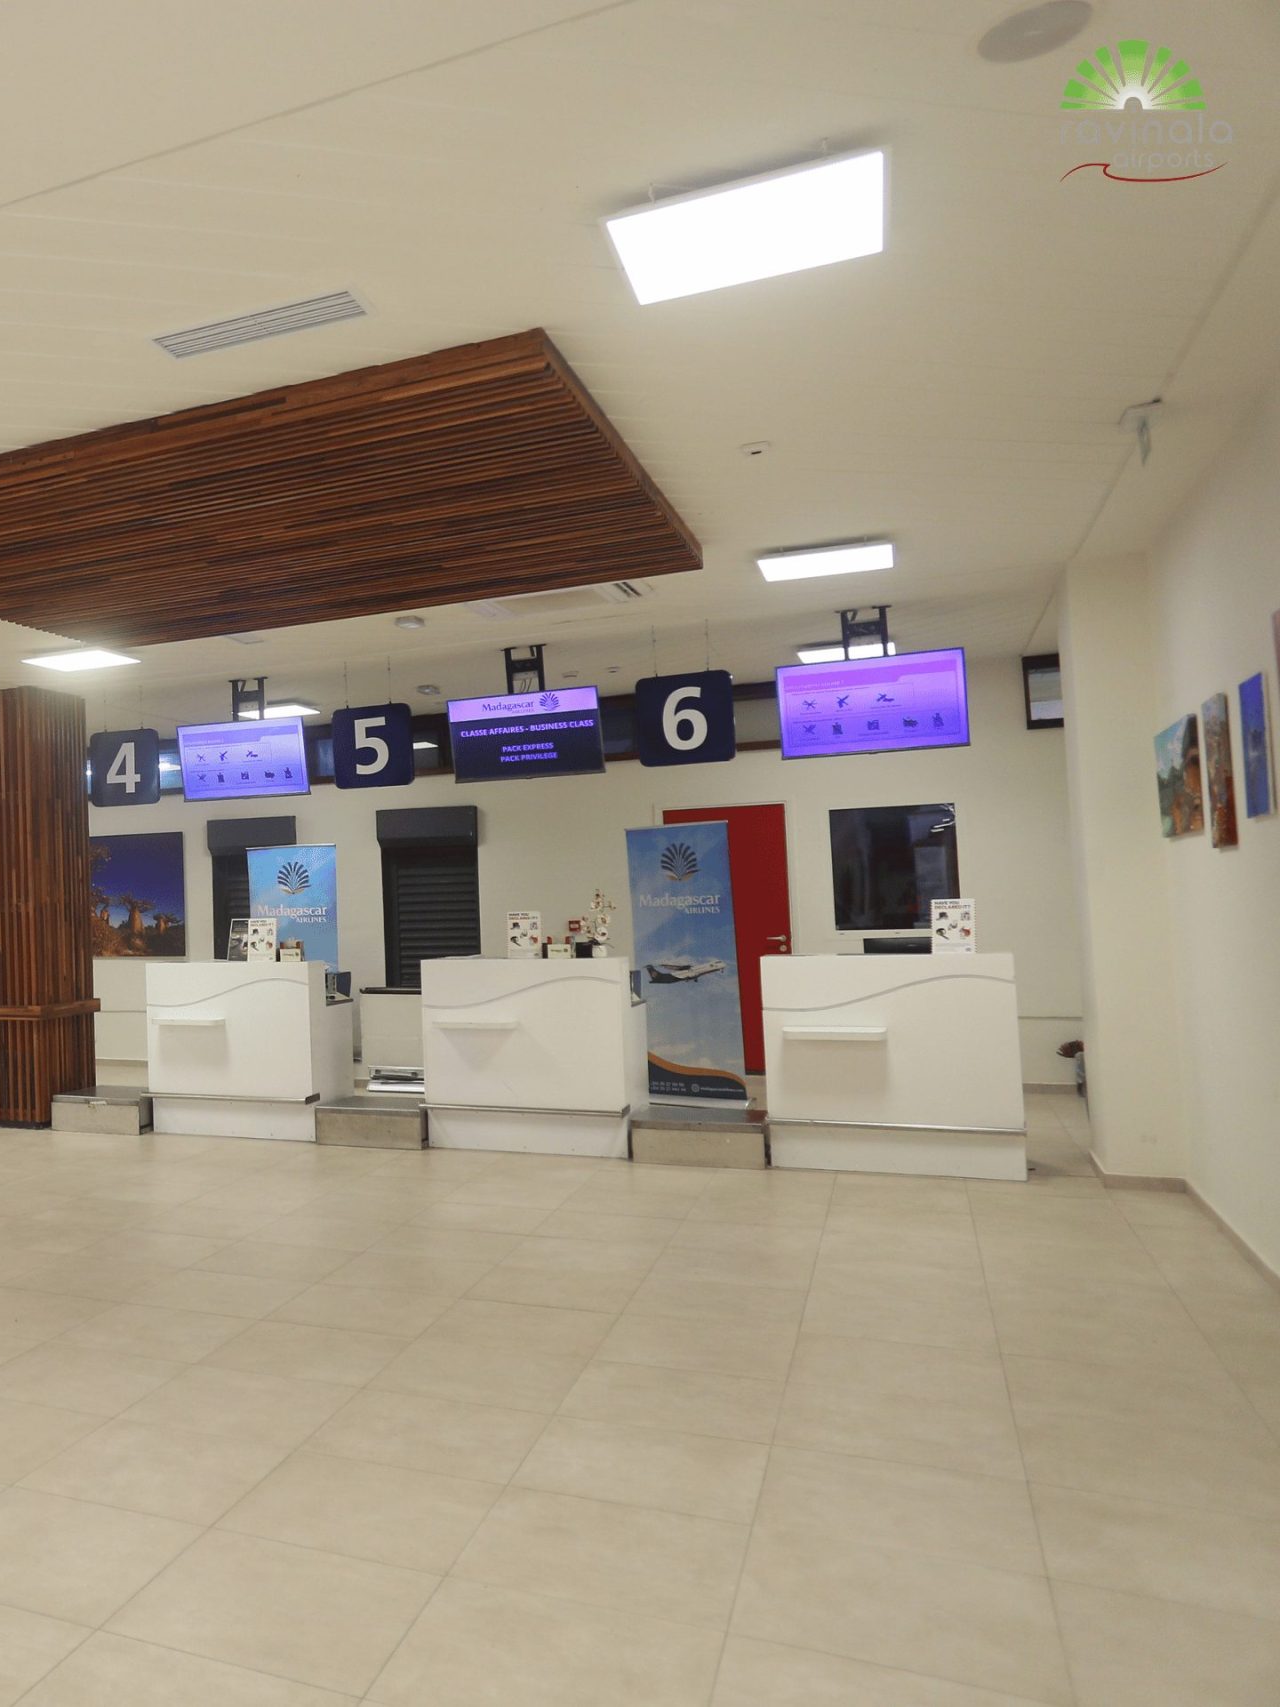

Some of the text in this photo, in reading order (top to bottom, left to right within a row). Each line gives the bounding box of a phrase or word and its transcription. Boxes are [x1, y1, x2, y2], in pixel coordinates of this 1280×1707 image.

[482, 700, 535, 713] Madagascar
[662, 686, 708, 750] 6
[461, 729, 488, 738] CLASSE
[489, 726, 524, 736] AFFAIRES
[530, 722, 568, 732] BUSINESS
[569, 719, 594, 728] CLASS
[354, 716, 390, 775] 5
[502, 742, 554, 753] PACK EXPRESS
[500, 754, 520, 763] PACK
[106, 742, 141, 794] 4
[639, 892, 721, 909] Madagascar
[257, 904, 328, 918] Madagascar
[685, 906, 720, 914] AIRLINES
